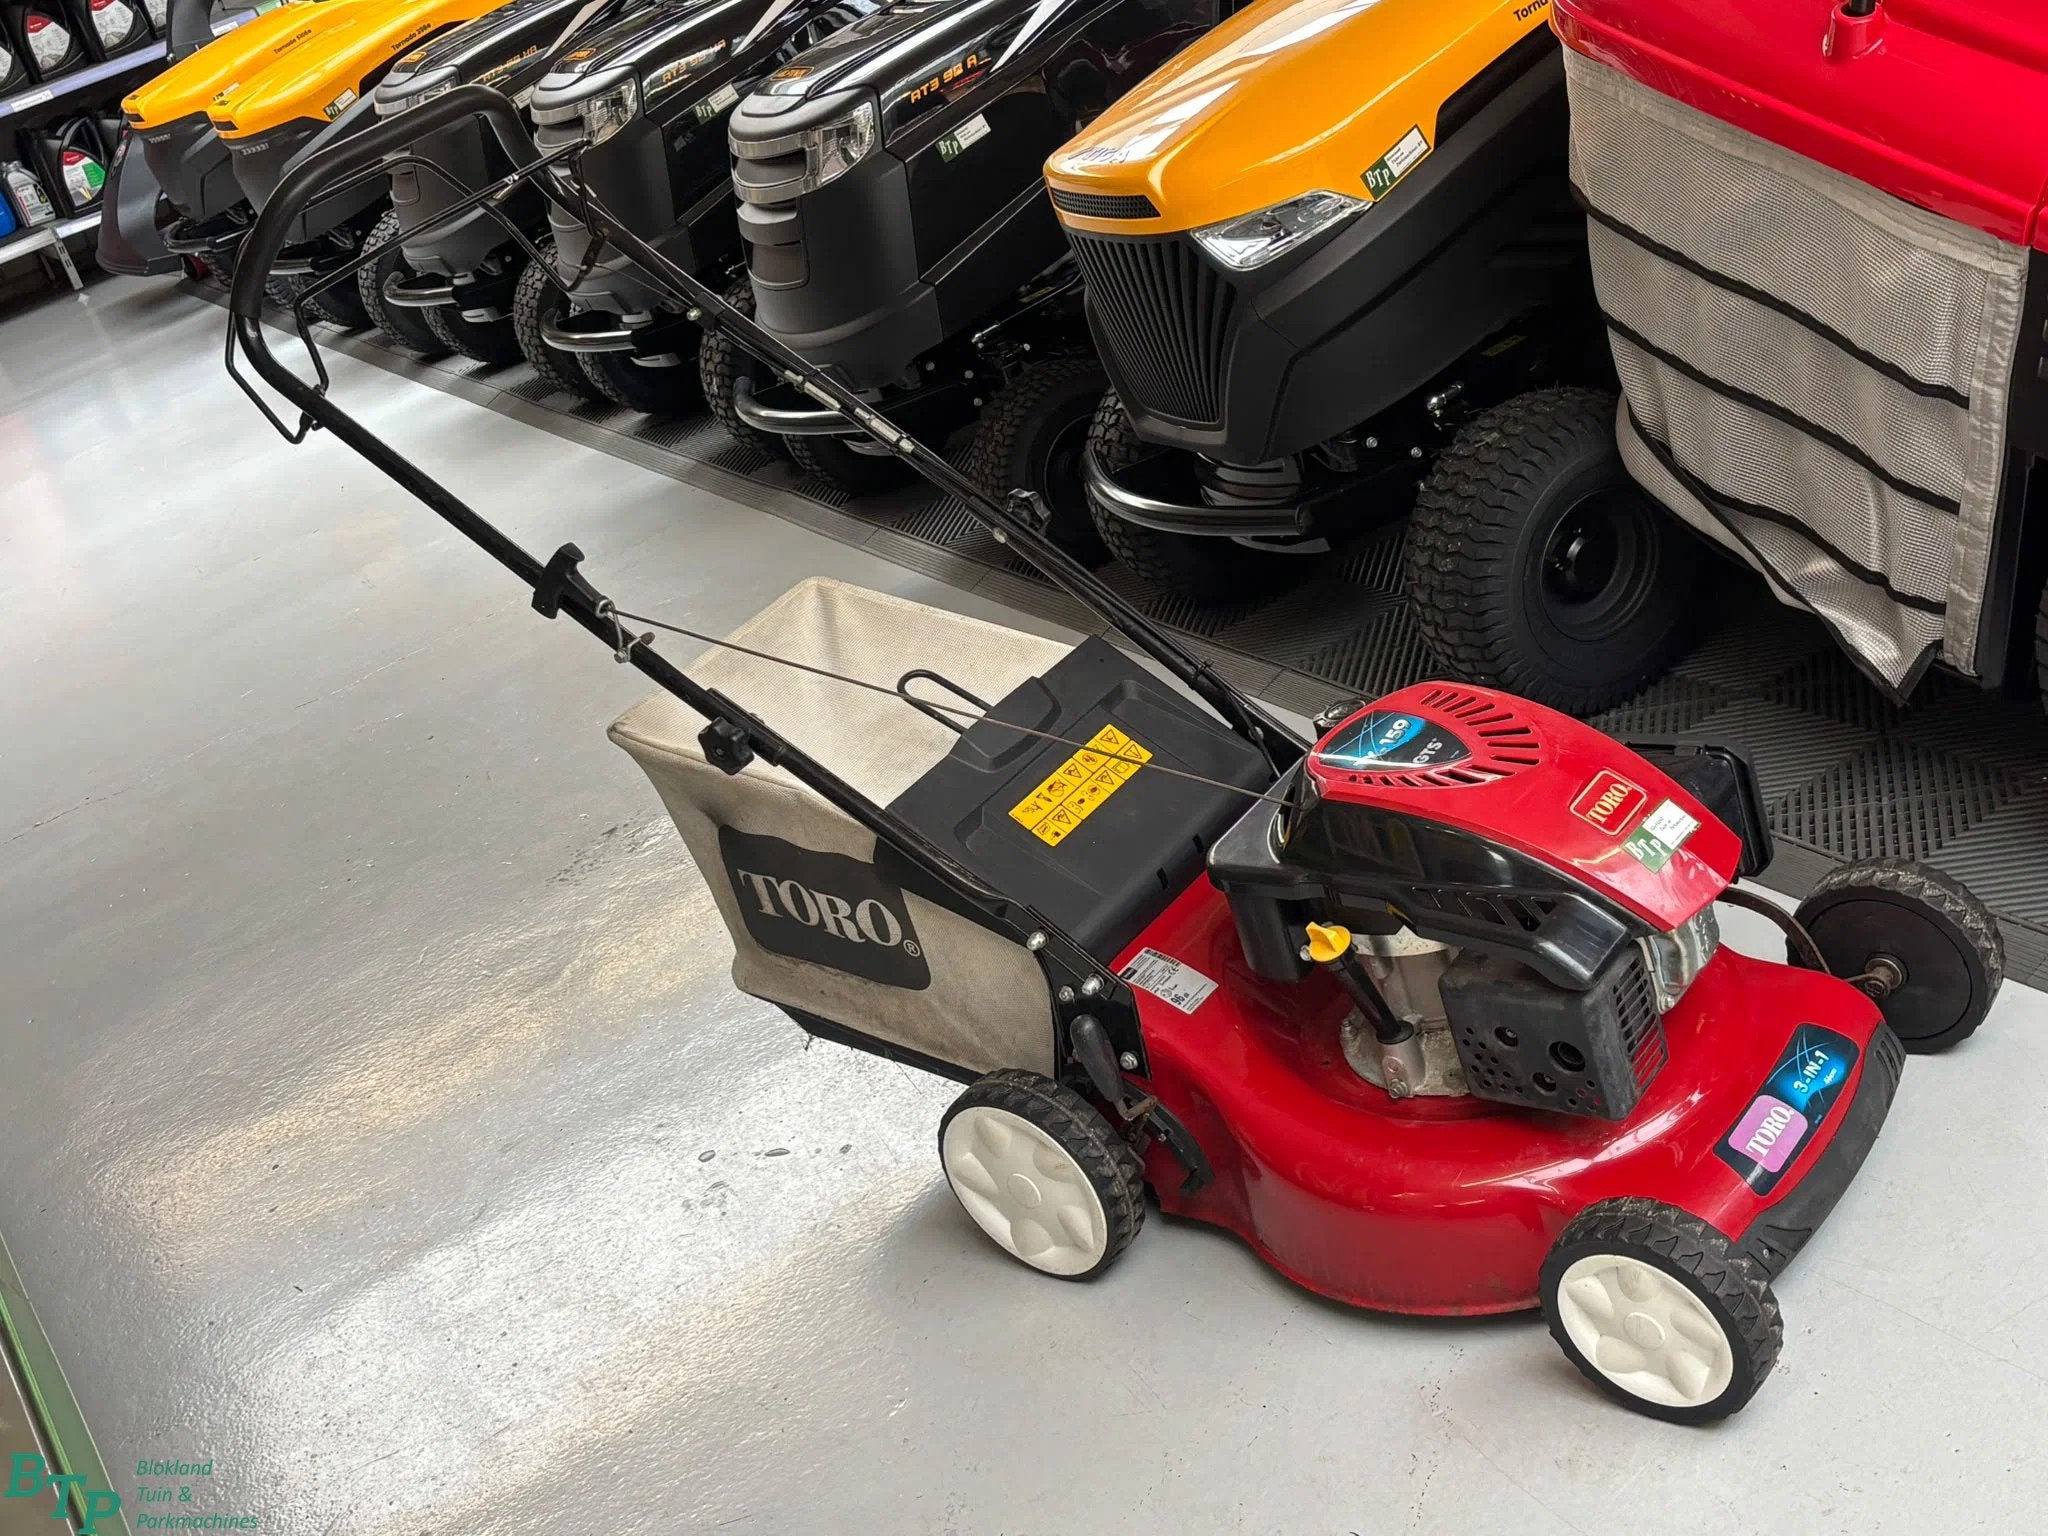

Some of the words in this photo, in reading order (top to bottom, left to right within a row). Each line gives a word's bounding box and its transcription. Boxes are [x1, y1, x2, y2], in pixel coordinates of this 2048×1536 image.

[910, 77, 940, 103] AT3
[966, 54, 978, 69] A
[938, 139, 959, 155] BTP
[1365, 168, 1391, 190] BTP
[1412, 739, 1444, 764] GTS
[1585, 783, 1629, 824] TORO
[1624, 838, 1668, 861] BTP
[737, 868, 903, 947] TORO
[1793, 1049, 1830, 1093] 3-IN-1
[1745, 1105, 1795, 1158] TORO
